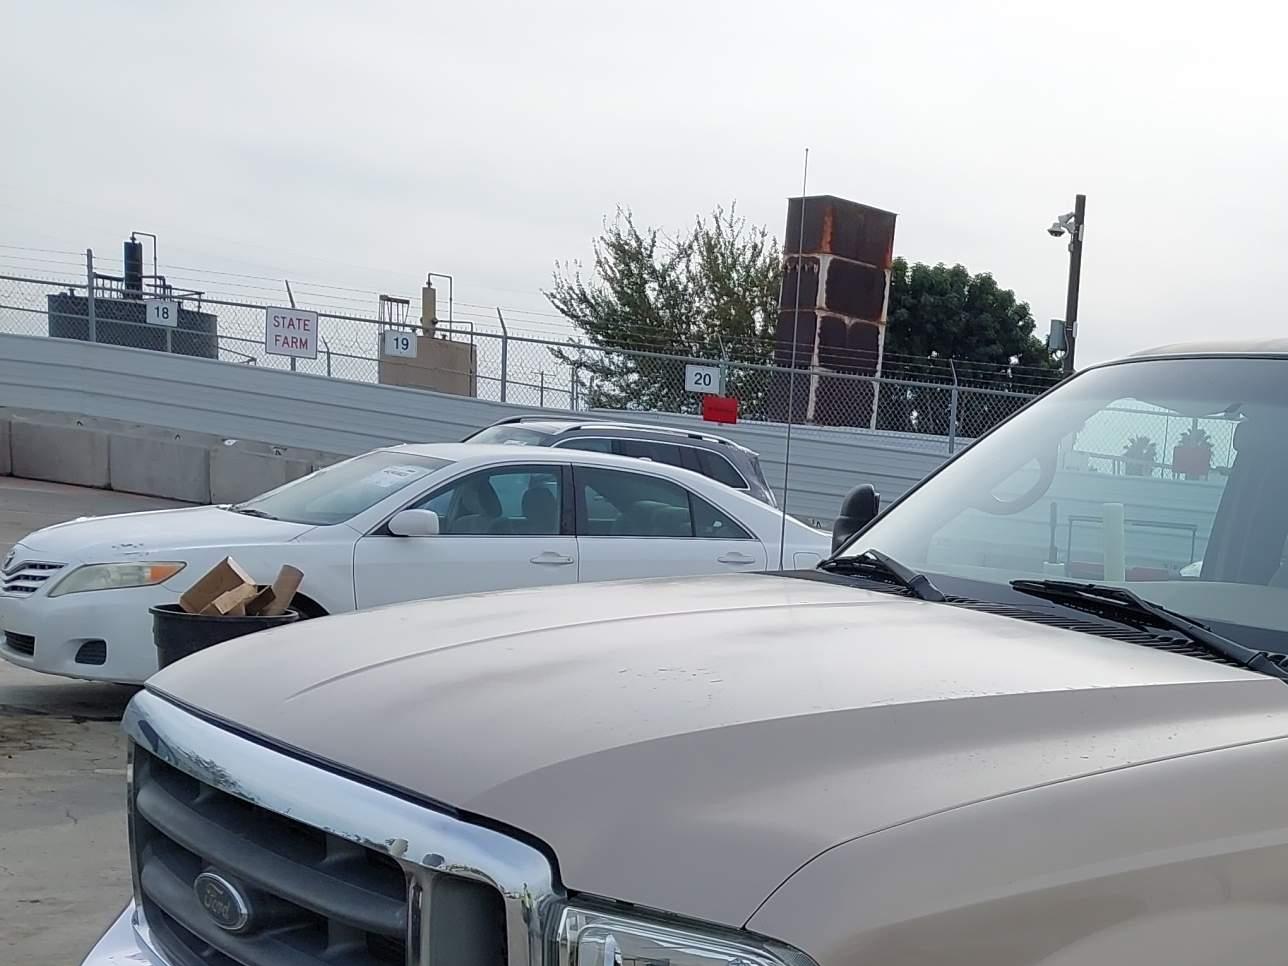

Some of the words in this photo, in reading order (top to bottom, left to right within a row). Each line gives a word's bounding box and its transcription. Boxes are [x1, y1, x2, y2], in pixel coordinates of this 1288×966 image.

[154, 307, 169, 320] 18
[273, 315, 311, 332] STATE
[275, 334, 308, 350] FARM
[393, 337, 409, 351] 19
[694, 372, 712, 387] 20
